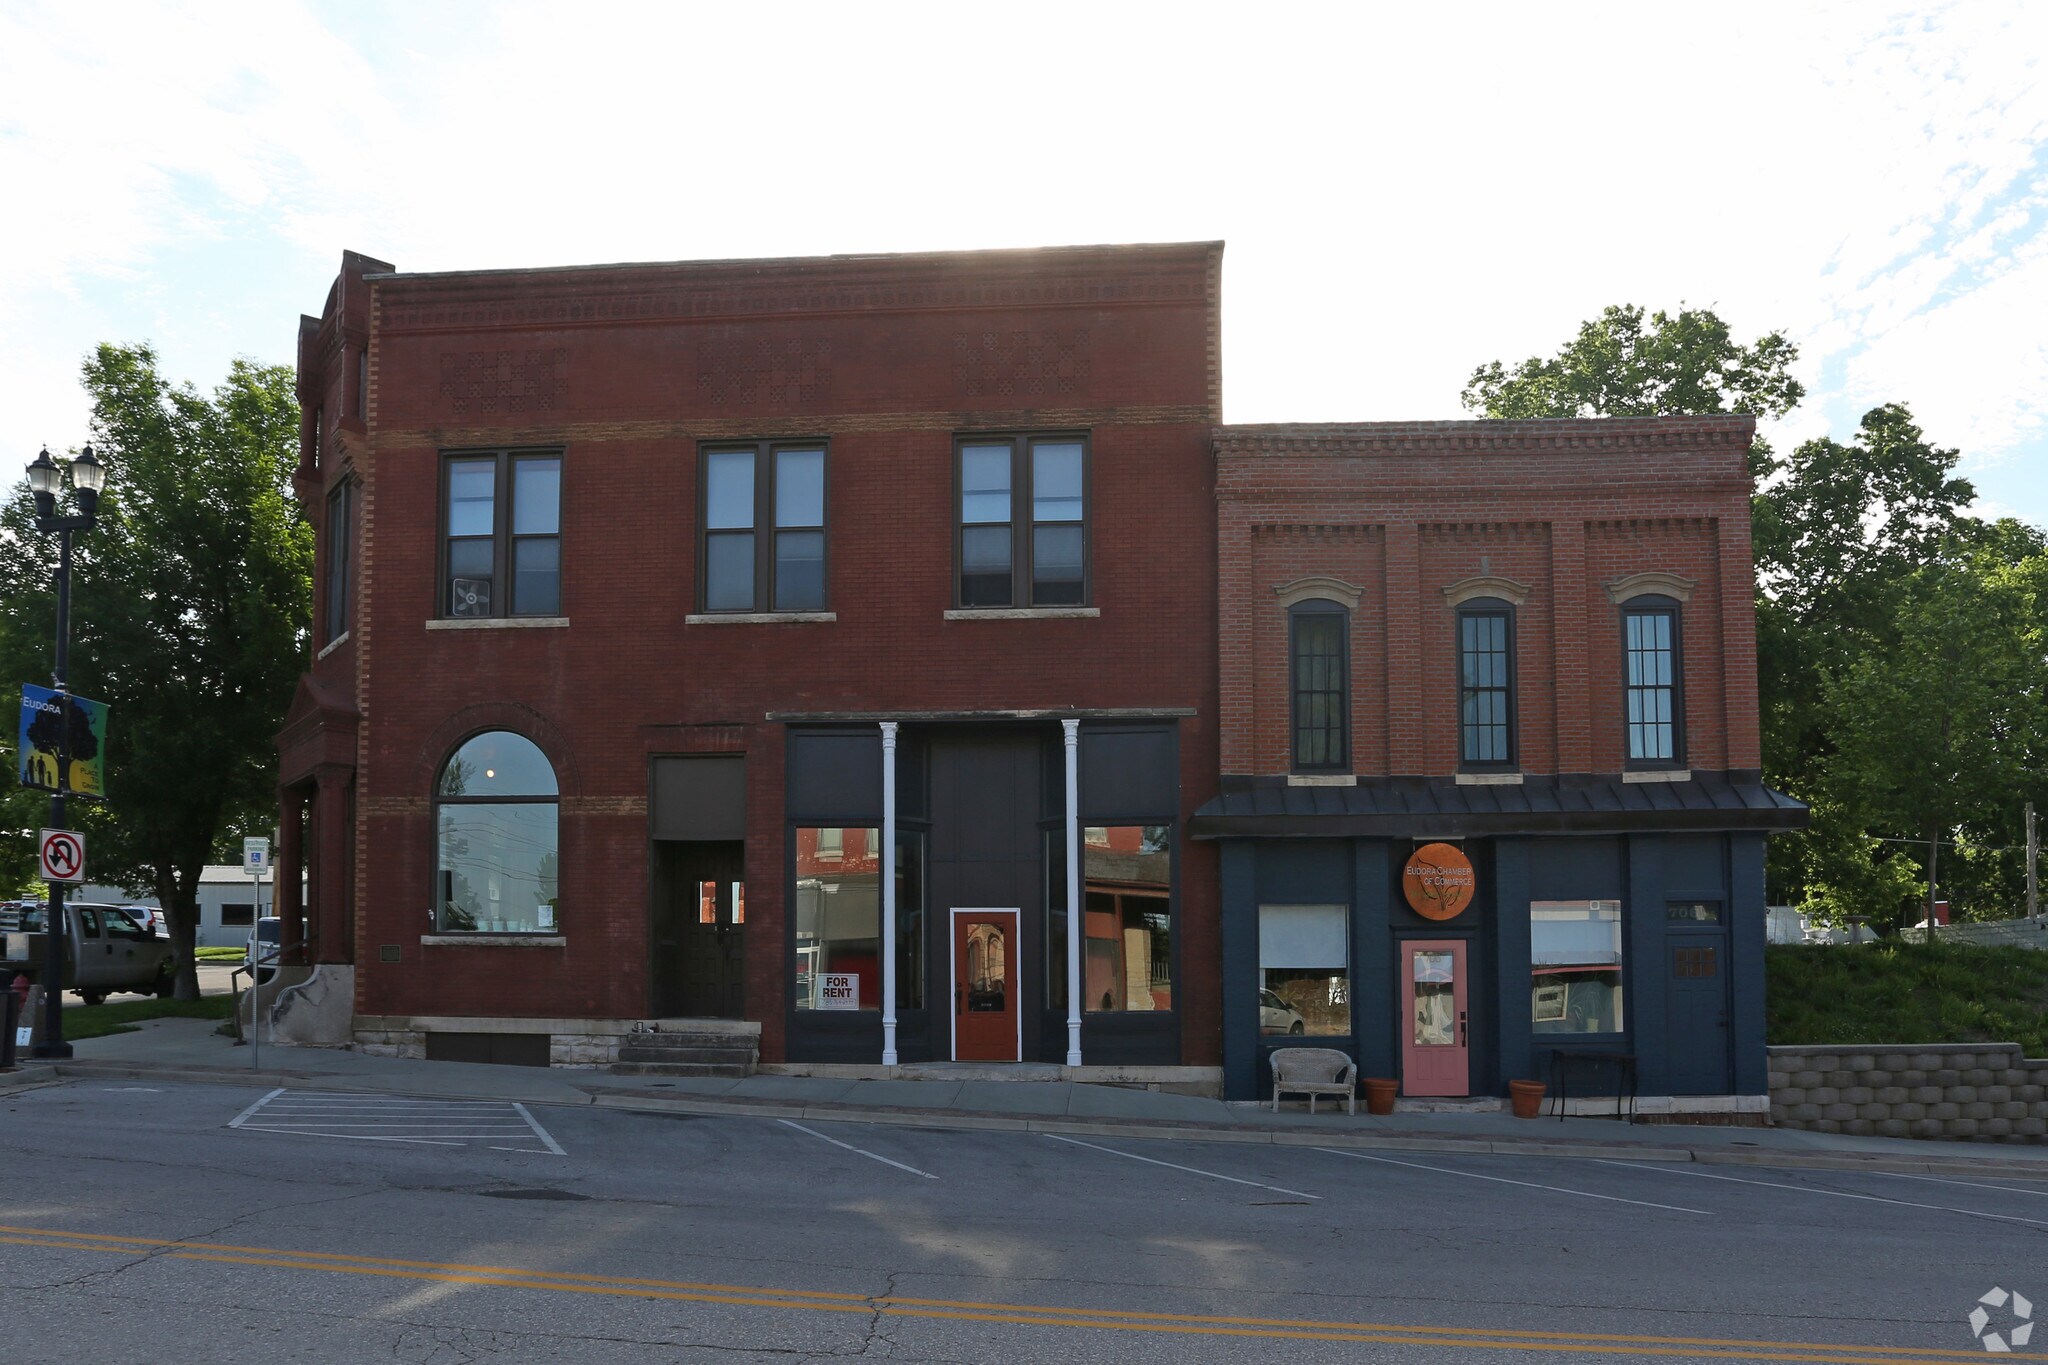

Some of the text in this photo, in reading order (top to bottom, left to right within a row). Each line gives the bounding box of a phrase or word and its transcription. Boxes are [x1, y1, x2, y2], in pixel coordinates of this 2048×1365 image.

[23, 696, 61, 715] EUDORA
[1406, 866, 1472, 876] EUDORA CHAMBER
[1434, 876, 1472, 886] COMMERCE
[826, 977, 849, 987] FOR
[822, 988, 853, 998] RENT
